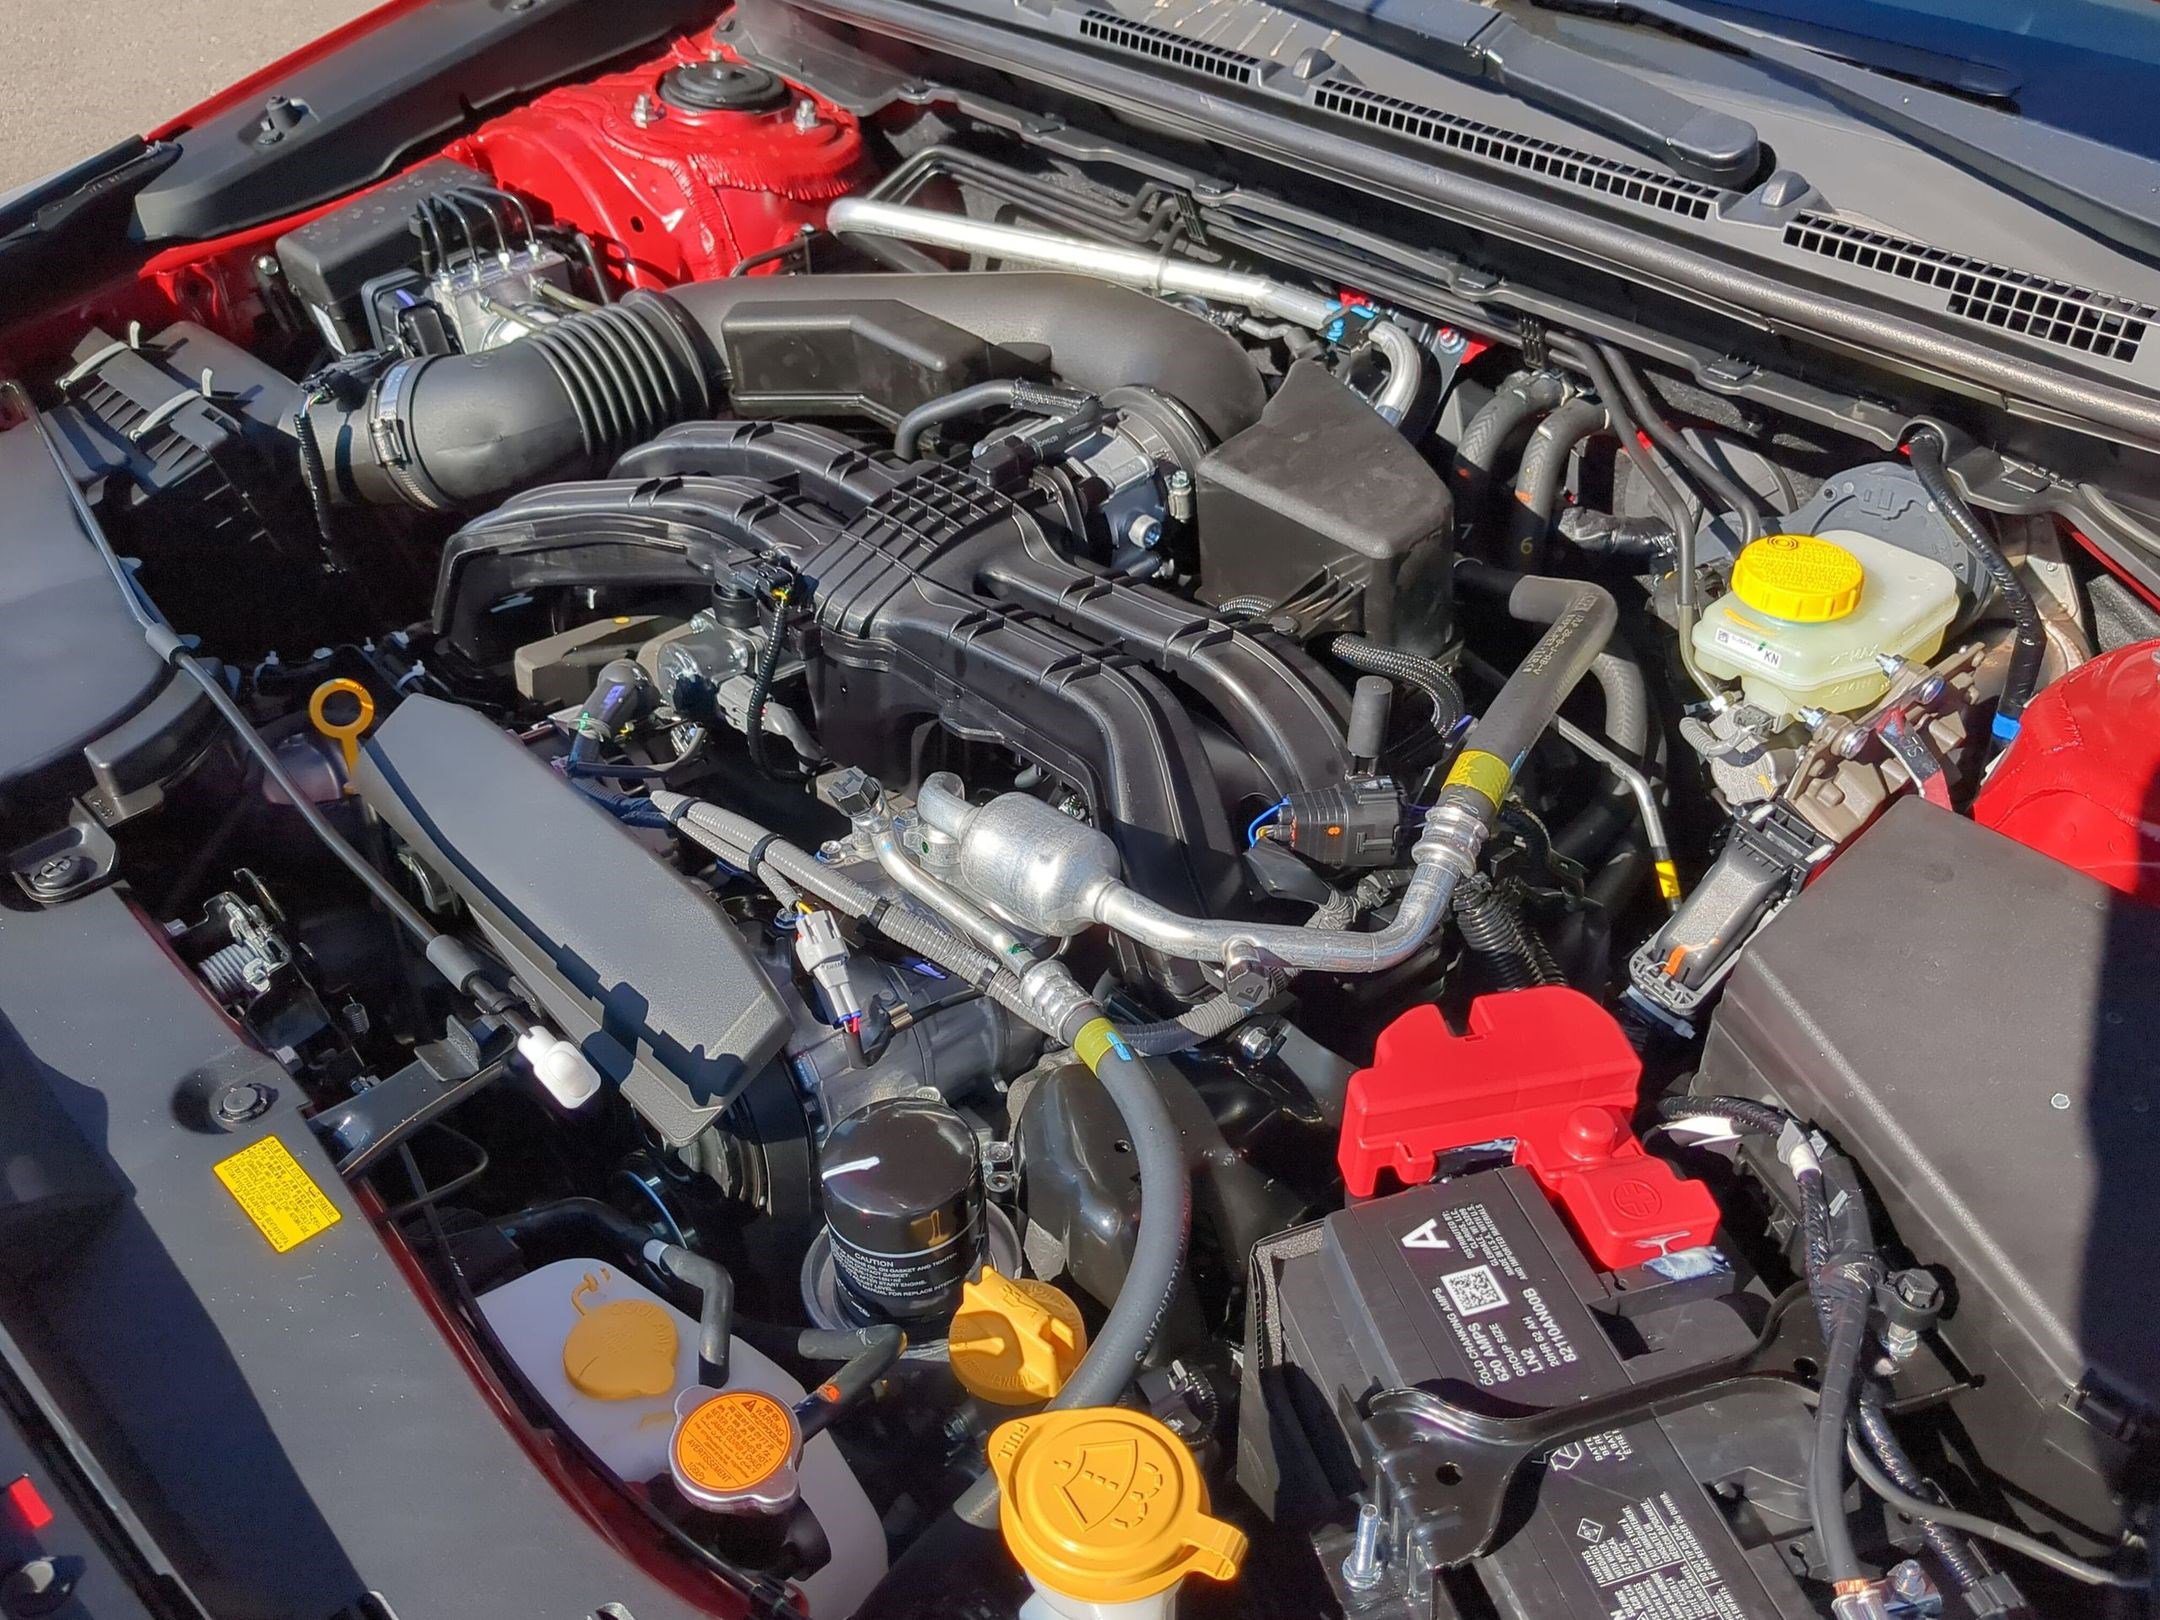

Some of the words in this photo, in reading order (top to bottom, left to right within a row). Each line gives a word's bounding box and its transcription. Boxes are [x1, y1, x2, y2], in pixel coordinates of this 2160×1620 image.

[1520, 536, 1533, 554] 6
[1764, 650, 1779, 665] KN
[1473, 1215, 1487, 1232] WITH
[1474, 1202, 1500, 1236] MATERIALS
[1401, 1218, 1450, 1249] A
[1447, 1220, 1475, 1259] DISTRIBUTED
[854, 1252, 894, 1267] CAUTION
[1494, 1235, 1519, 1266] IMPORTED
[1498, 1257, 1515, 1276] MADE
[1513, 1266, 1527, 1280] AND
[1431, 1286, 1453, 1313] AMPS
[1488, 1322, 1507, 1343] SIZE
[1521, 1315, 1538, 1331] AH
[1521, 1286, 1577, 1362] 82110AN00B
[1445, 1312, 1480, 1360] CRANKING
[1466, 1321, 1497, 1358] AMPS
[1531, 1330, 1545, 1342] 62
[1500, 1342, 1527, 1377] GROUP
[1519, 1346, 1544, 1372] LN2
[1538, 1341, 1560, 1367] 20HR
[1472, 1358, 1495, 1386] COLD
[1488, 1358, 1511, 1382] 620
[754, 1407, 785, 1436] WARNING
[709, 1407, 728, 1426] NEVER
[725, 1424, 742, 1440] OPEN
[739, 1438, 757, 1454] WHEN
[755, 1452, 768, 1465] HOT
[686, 1438, 731, 1483] AVERTISSEMENT
[1672, 1513, 1684, 1524] OU
[1620, 1521, 1635, 1538] YEUX
[1605, 1536, 1626, 1563] MEDICAL
[1647, 1531, 1672, 1562] CONSULTEZ
[1678, 1523, 1705, 1558] RENVERSER
[1678, 1539, 1689, 1549] OR
[1580, 1549, 1594, 1565] EYES
[1588, 1543, 1615, 1581] IMMEDIATELY
[1627, 1555, 1642, 1572] HELP
[1684, 1549, 1695, 1559] TIP
[1699, 1557, 1712, 1570] PAS
[1589, 1563, 1606, 1584] FLUSH
[1609, 1561, 1624, 1578] WITH
[1620, 1562, 1633, 1575] GET
[1690, 1559, 1704, 1572] NOT
[1706, 1569, 1718, 1579] NE
[1676, 1579, 1689, 1590] DES
[1698, 1572, 1710, 1582] DO
[1613, 1589, 1636, 1617] SULFURIC
[1669, 1584, 1687, 1605] CAUSER
